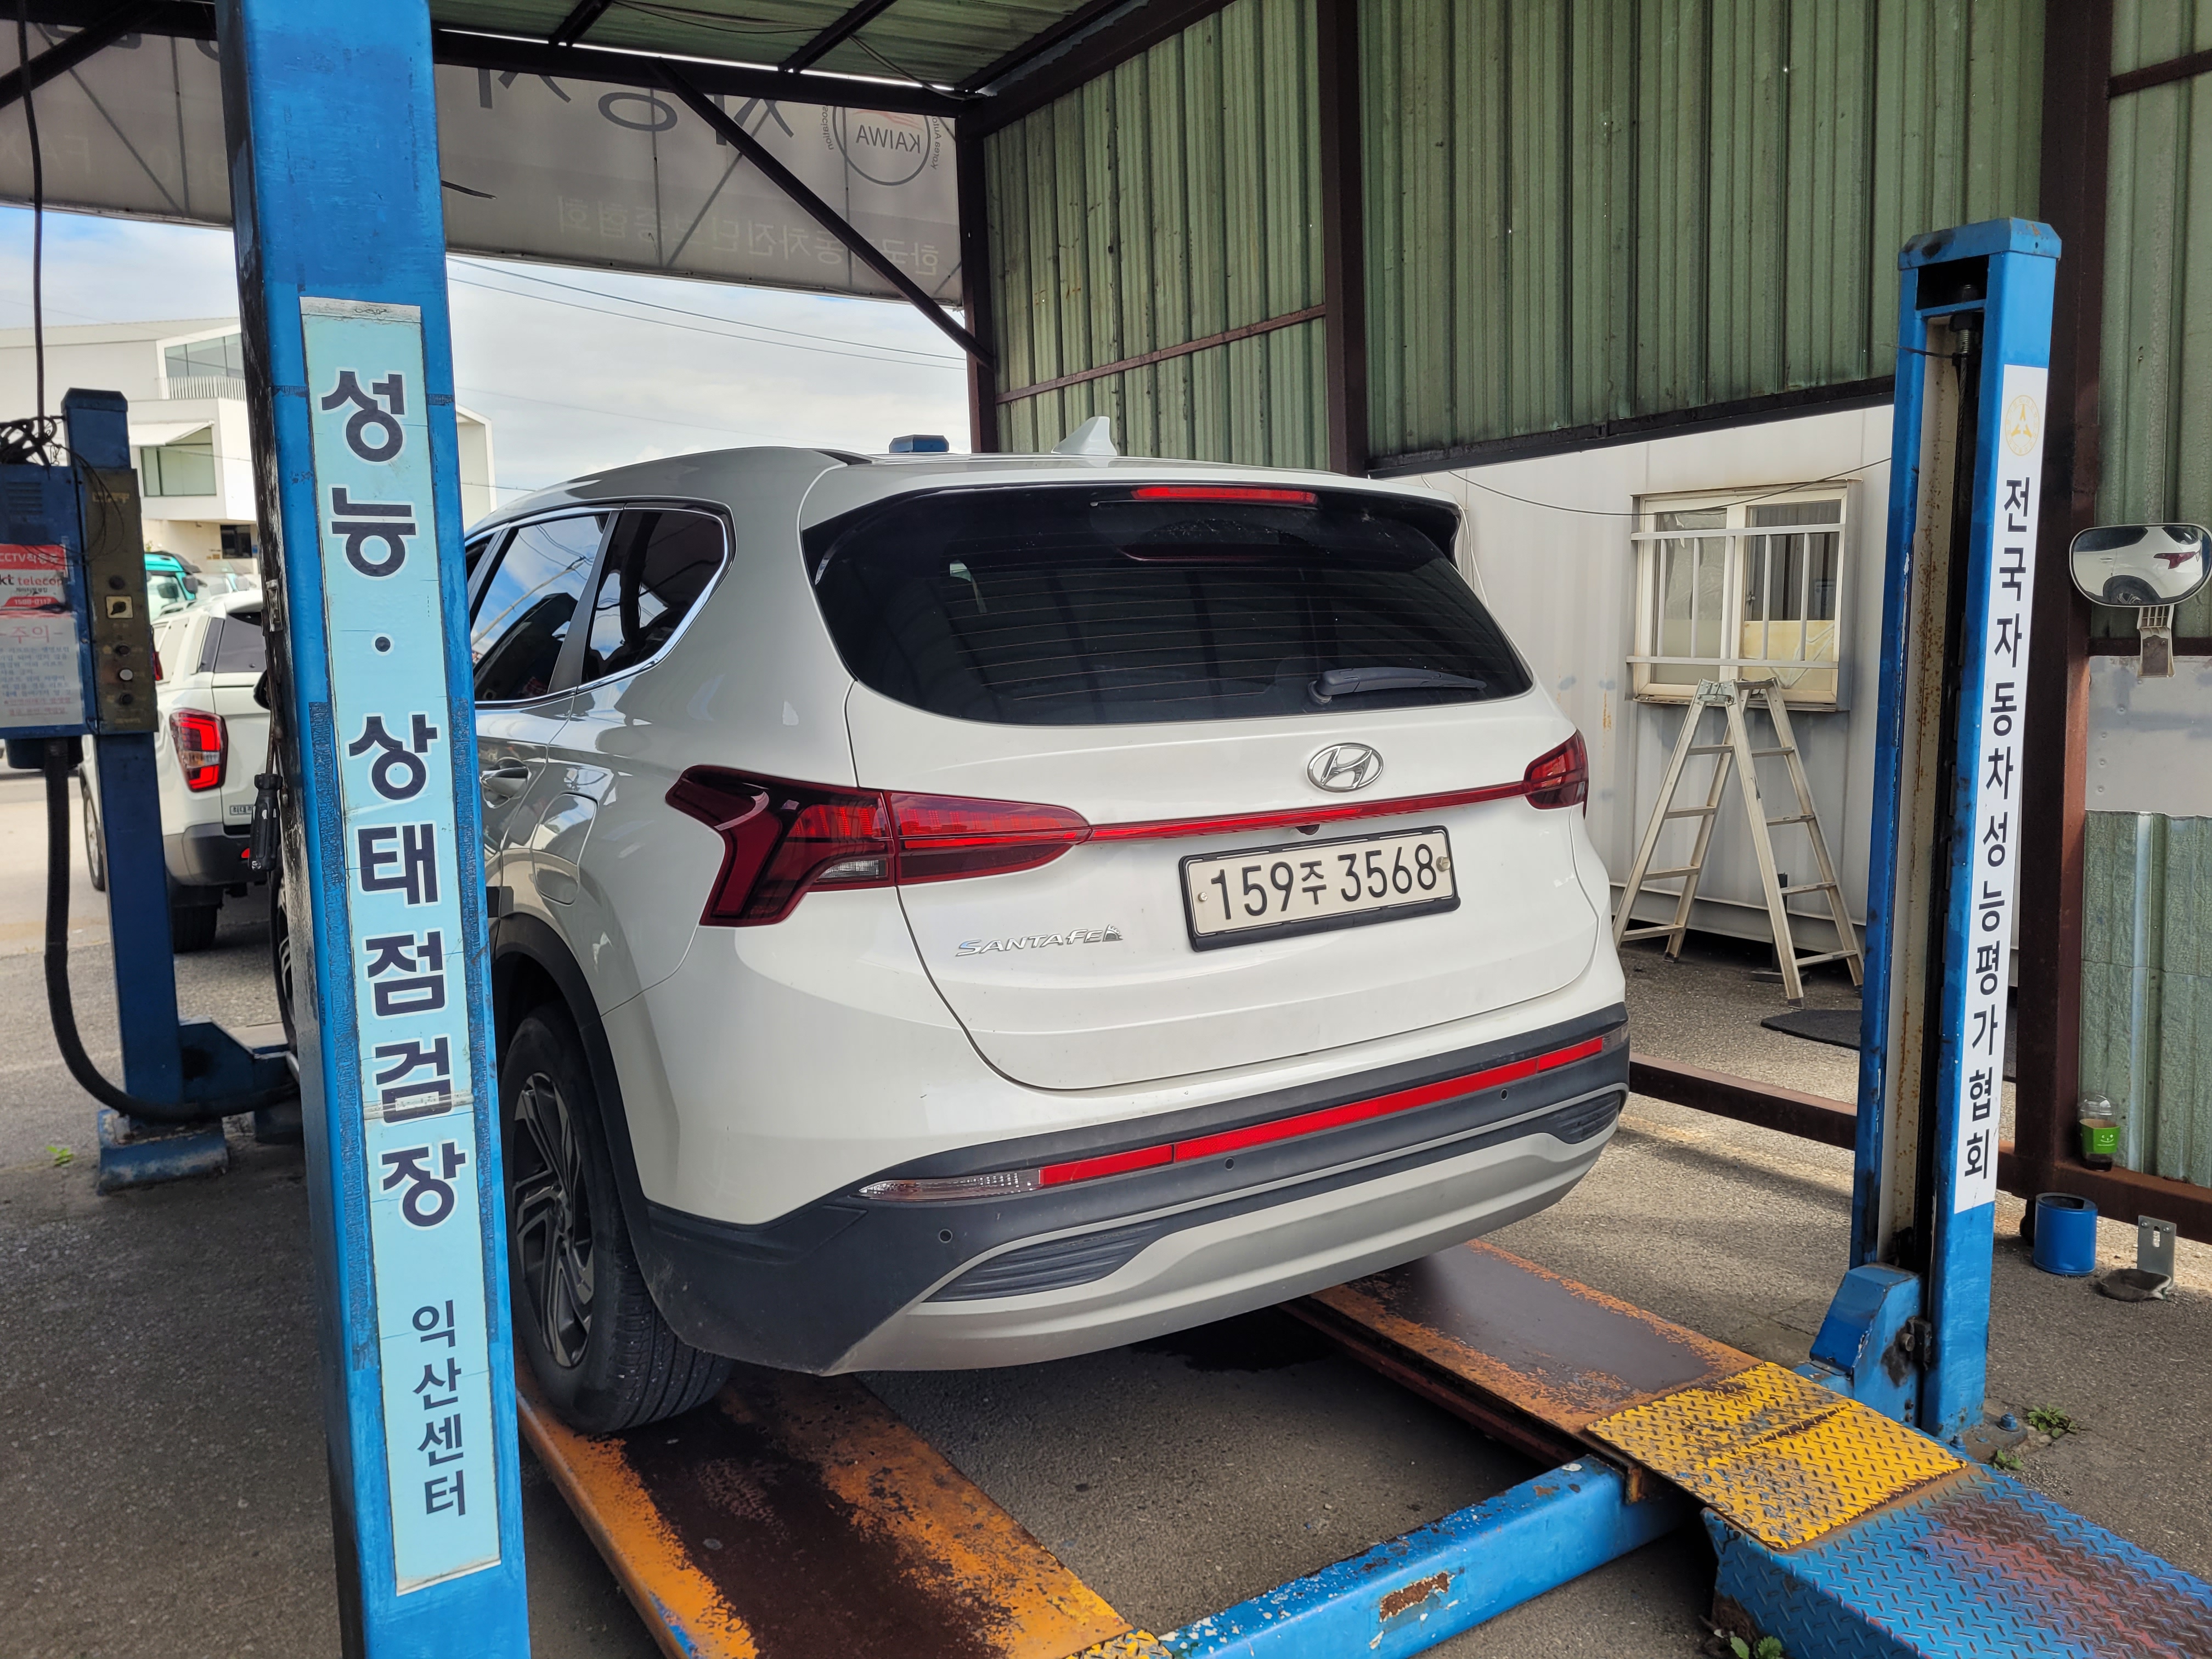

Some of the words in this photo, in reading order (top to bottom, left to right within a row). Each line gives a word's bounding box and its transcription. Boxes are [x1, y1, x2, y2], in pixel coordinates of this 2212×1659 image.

[1338, 844, 1437, 902] 3568
[1965, 476, 2029, 1180] 전국자동차성능평가협회
[413, 1299, 466, 1516] 익산센터
